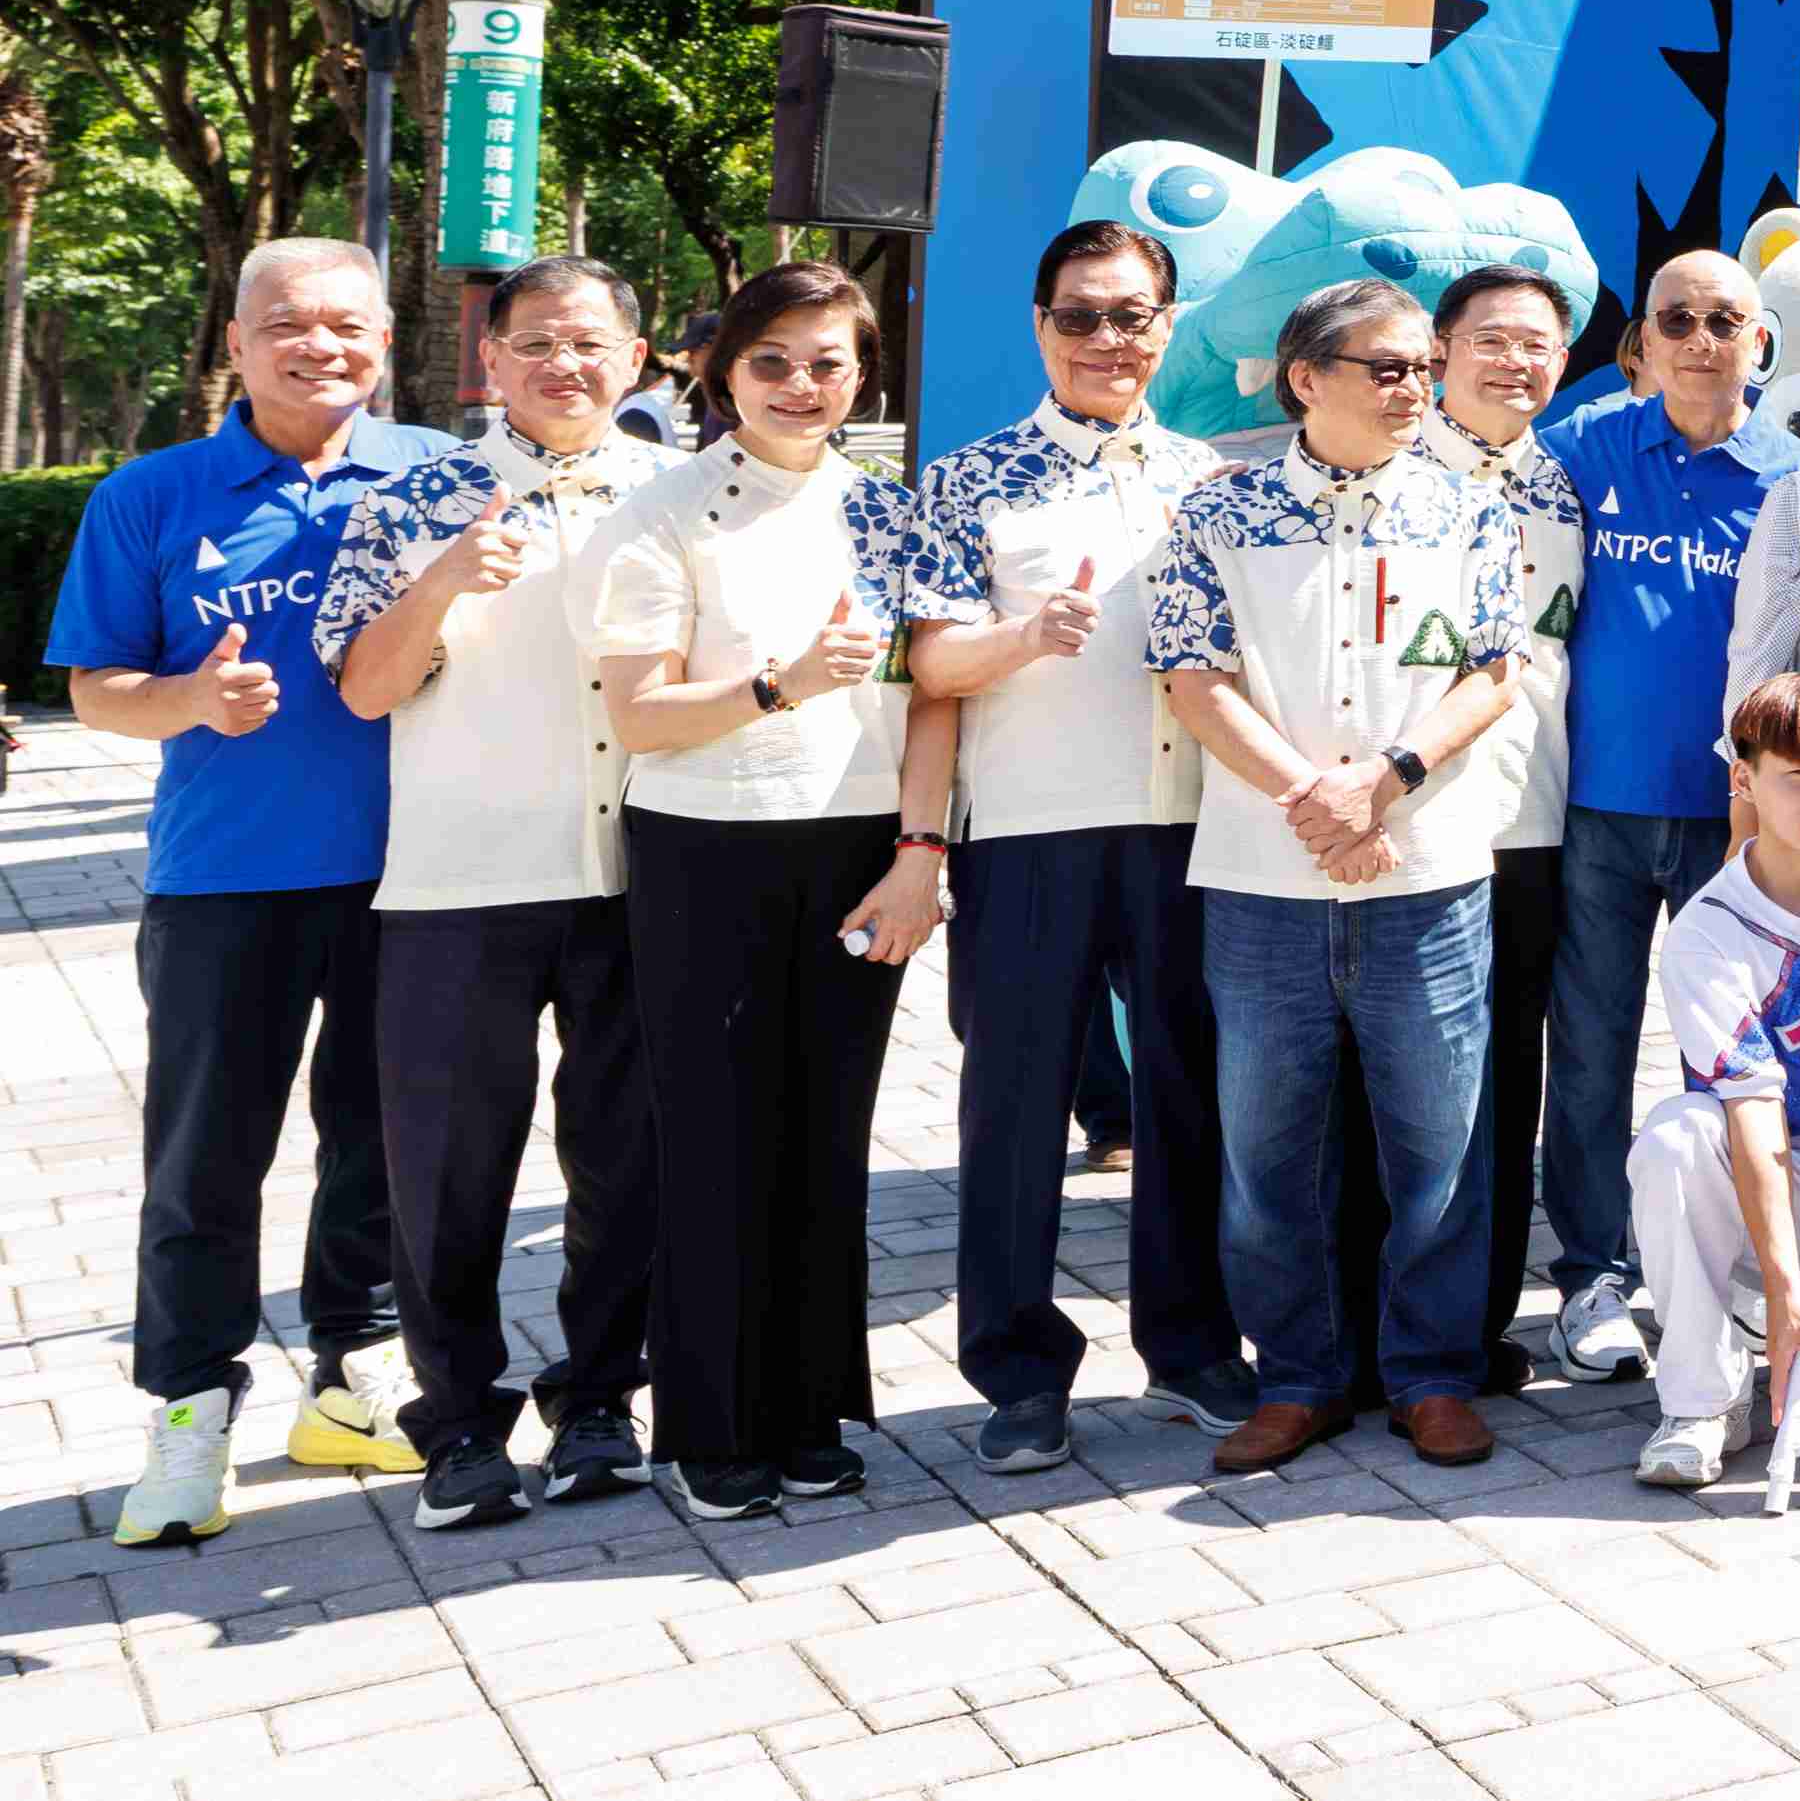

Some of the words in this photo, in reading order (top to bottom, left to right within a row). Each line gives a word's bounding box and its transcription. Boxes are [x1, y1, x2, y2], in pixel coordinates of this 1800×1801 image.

[483, 9, 521, 45] 9
[1592, 529, 1673, 564] NTPC
[191, 569, 317, 626] NTPC
